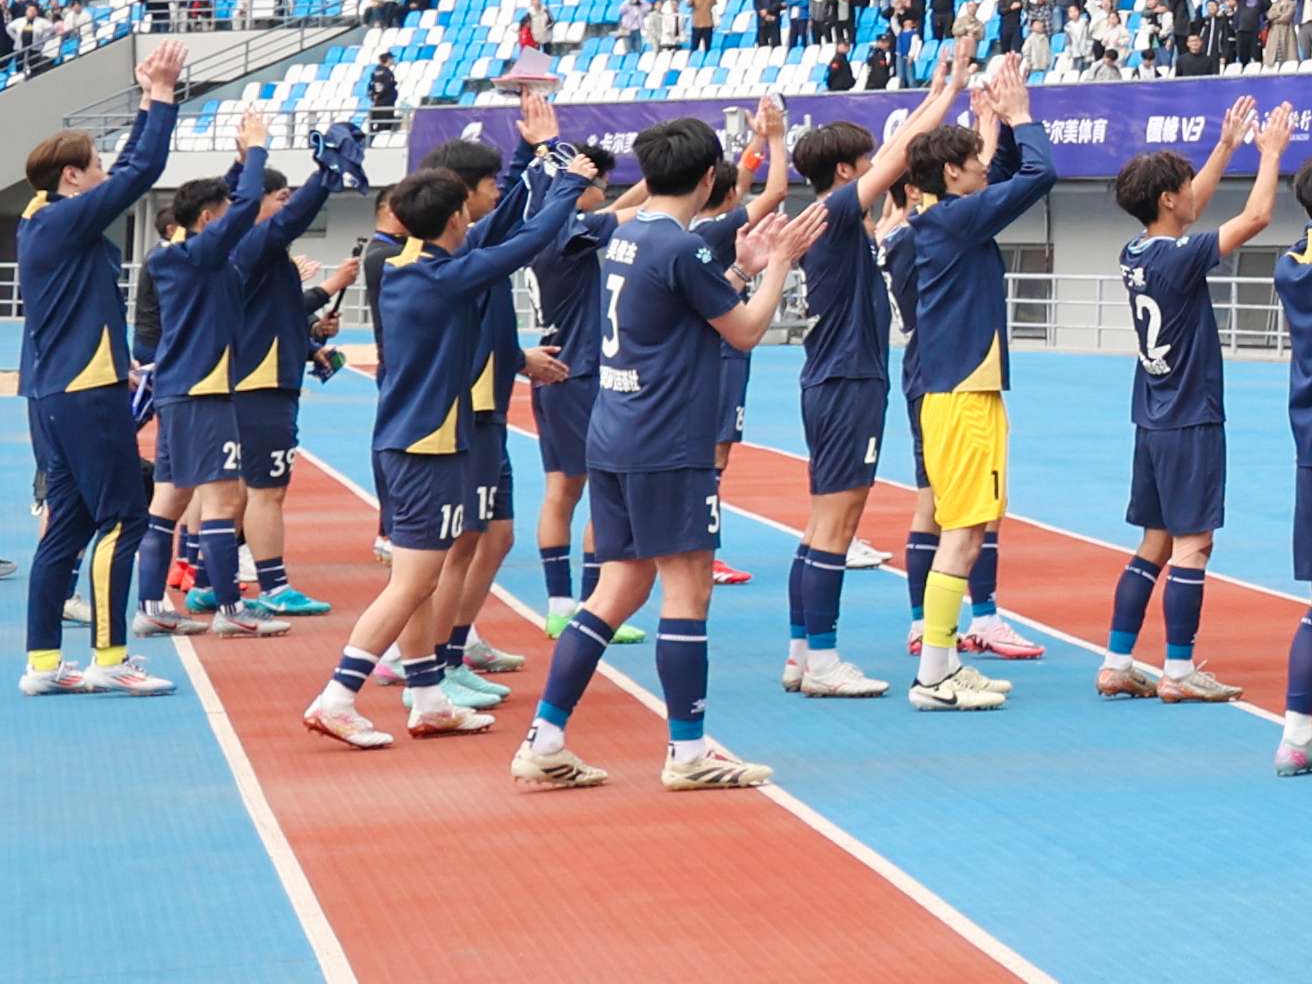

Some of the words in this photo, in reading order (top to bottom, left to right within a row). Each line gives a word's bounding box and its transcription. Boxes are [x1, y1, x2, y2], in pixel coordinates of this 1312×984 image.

[601, 273, 626, 358] 3
[440, 504, 464, 540] 10
[705, 495, 719, 534] 3
